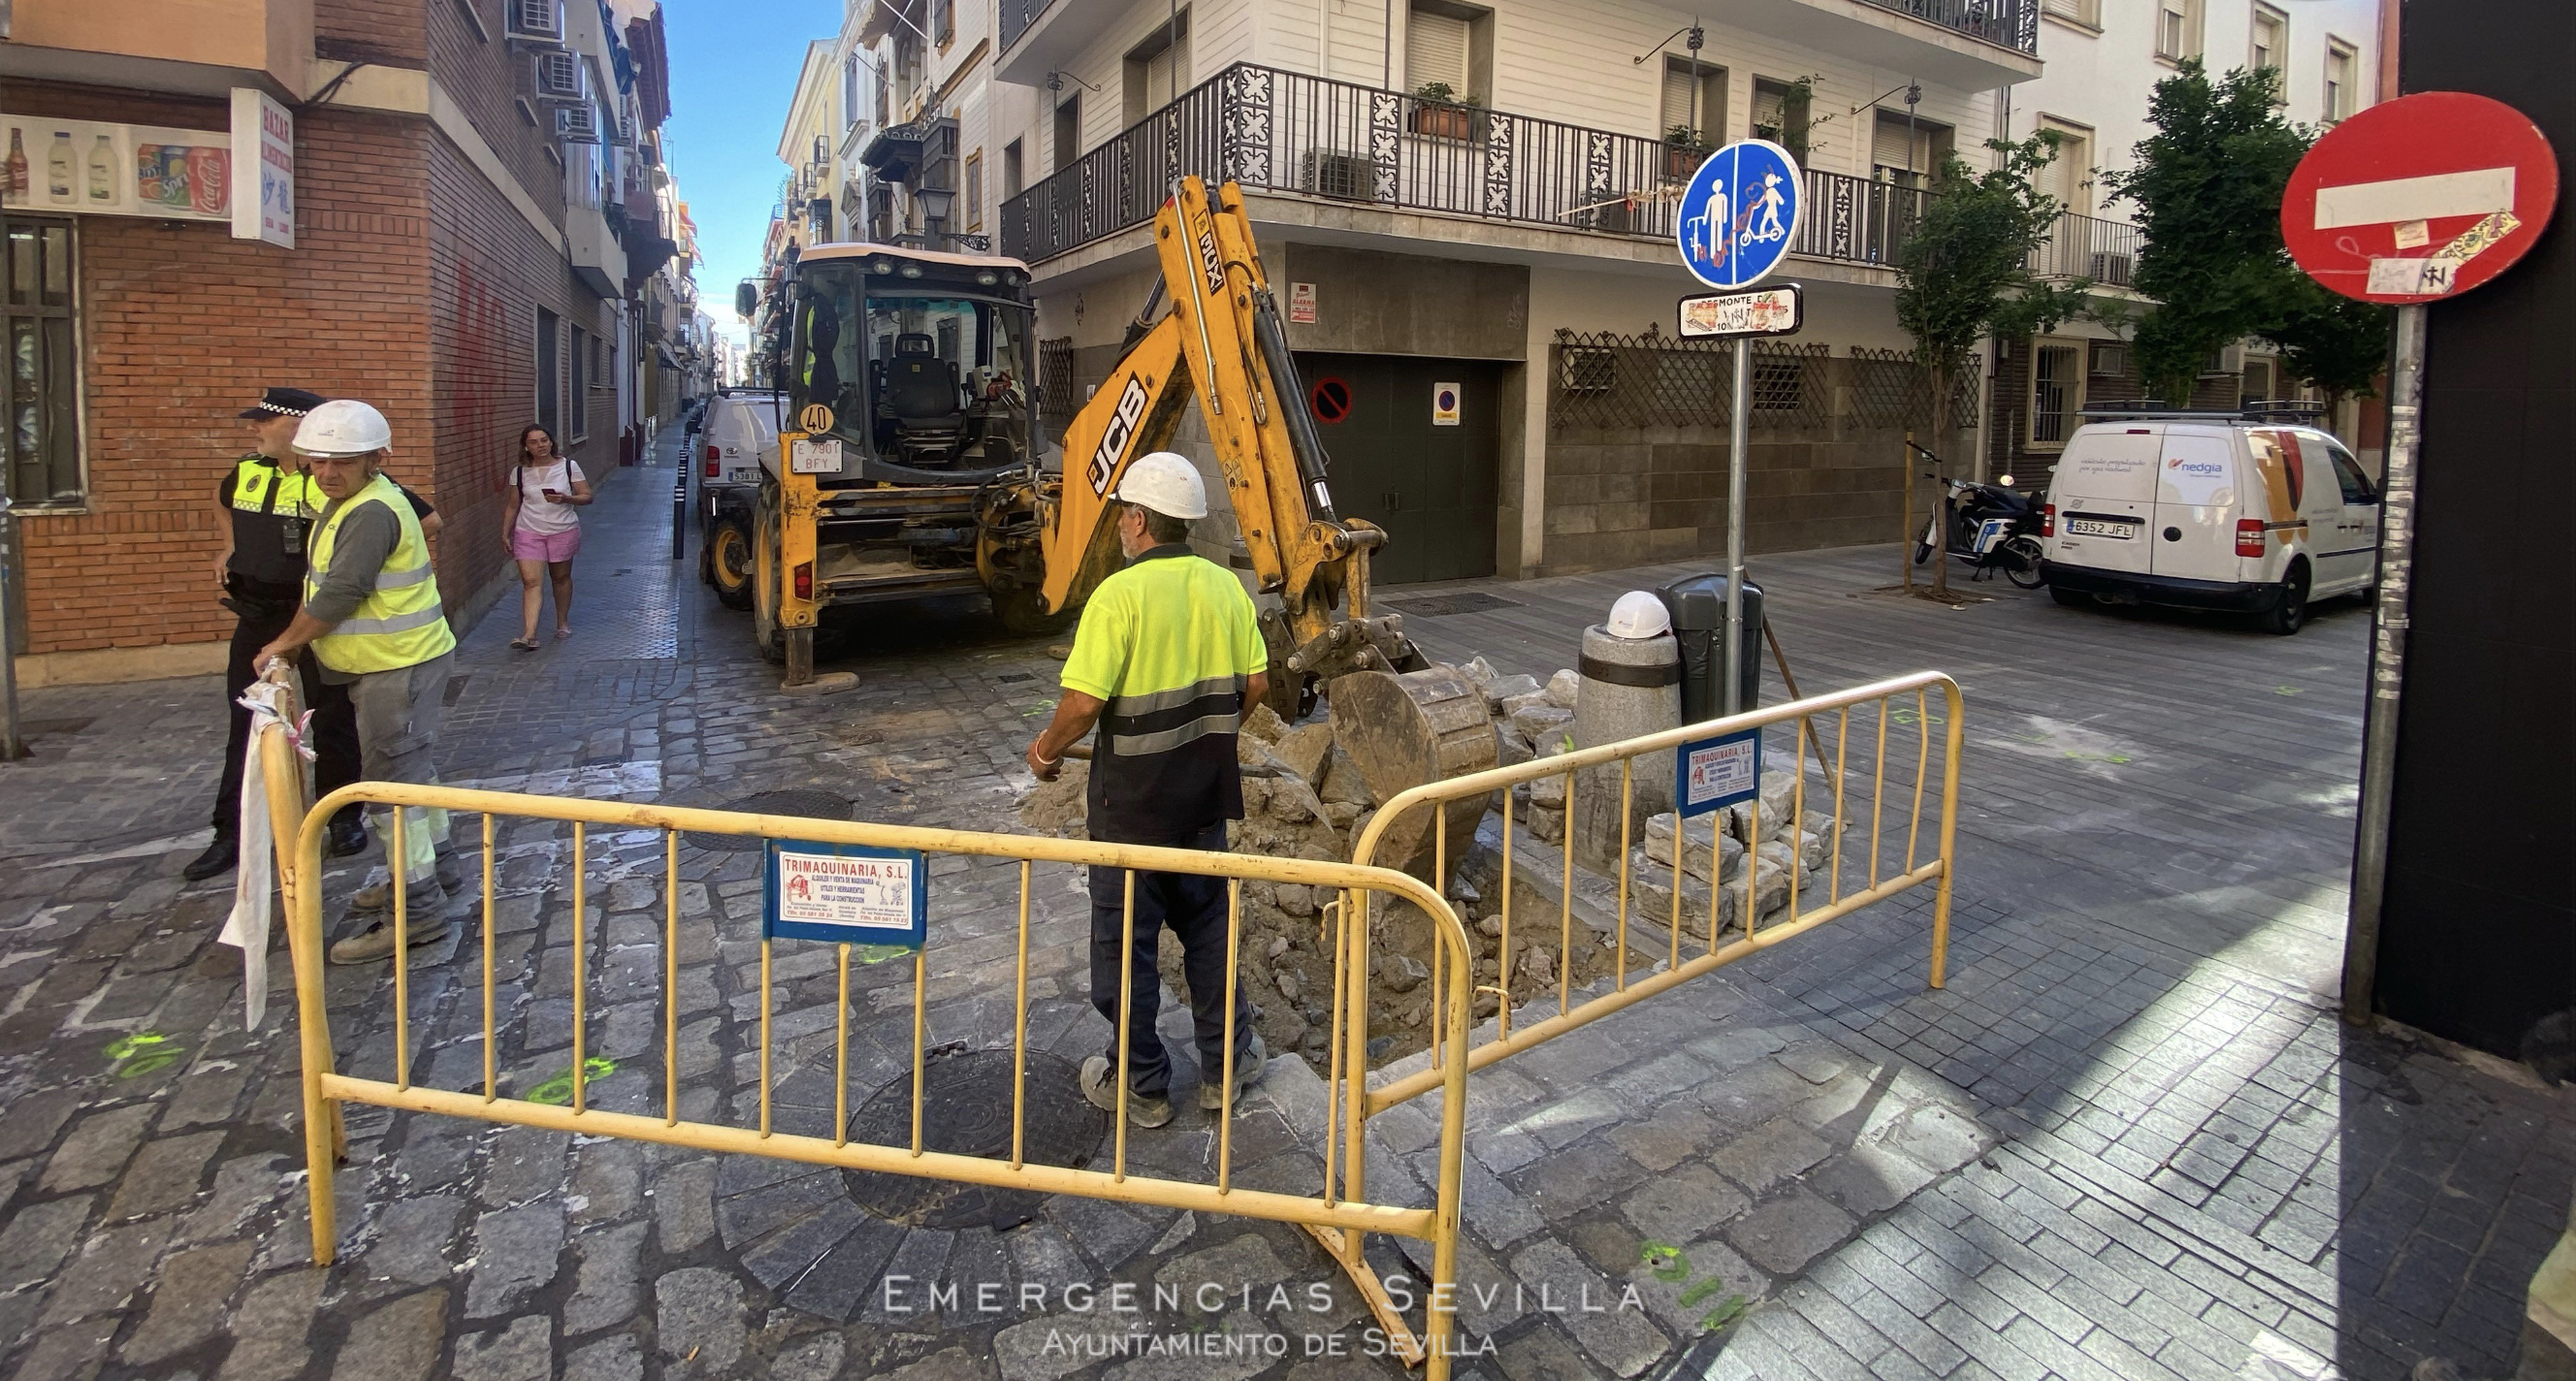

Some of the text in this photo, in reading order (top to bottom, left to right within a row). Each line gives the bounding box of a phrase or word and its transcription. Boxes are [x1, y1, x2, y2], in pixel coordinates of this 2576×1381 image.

[263, 105, 290, 145] BAZAR
[806, 406, 826, 431] 40
[1094, 379, 1145, 495] JCB
[797, 443, 839, 455] E 7901
[805, 458, 828, 469] BFY
[2181, 463, 2223, 474] nedgia
[2076, 521, 2131, 536] 6352 JFL
[785, 858, 908, 880] TRIMAQUINARIA, S.L.
